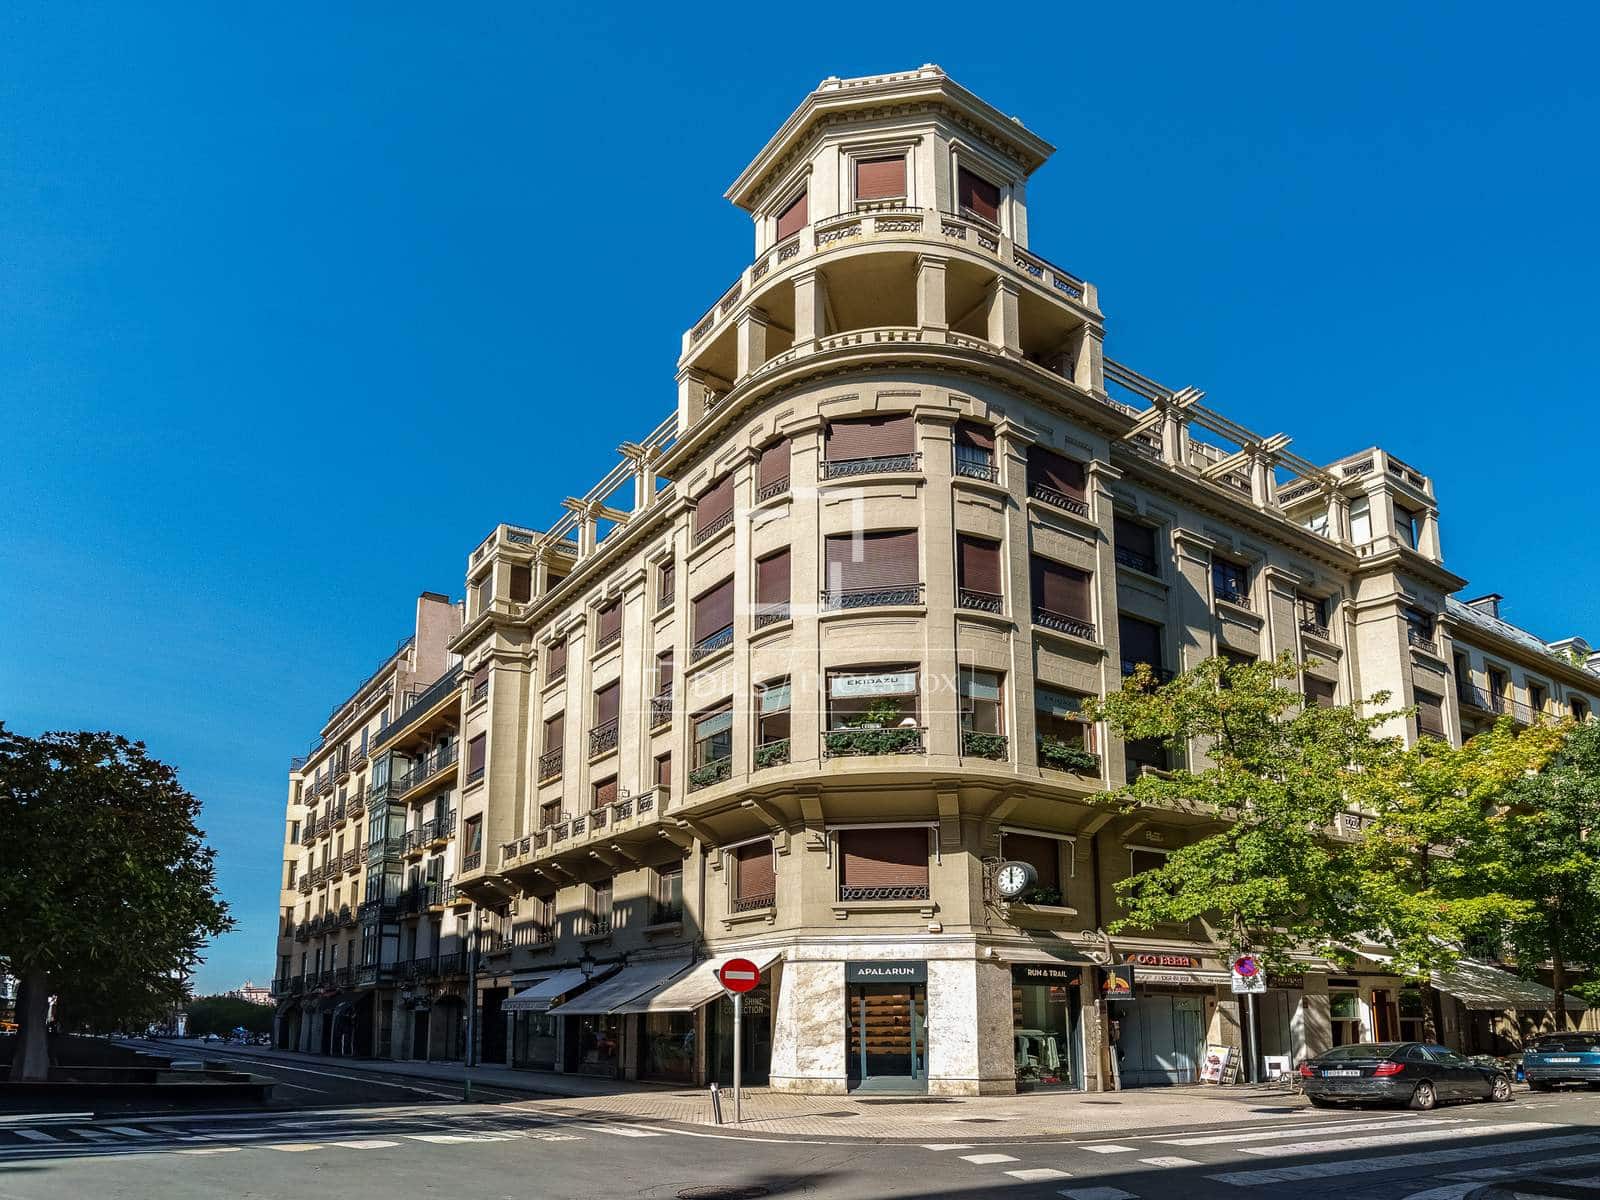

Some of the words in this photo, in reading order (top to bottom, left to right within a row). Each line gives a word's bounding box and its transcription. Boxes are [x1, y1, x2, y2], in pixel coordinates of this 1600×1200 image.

[847, 677, 898, 685] EKIDAZU
[858, 967, 915, 975] APALARUN
[1027, 968, 1042, 976] RUN
[723, 1005, 764, 1015] COECTION
